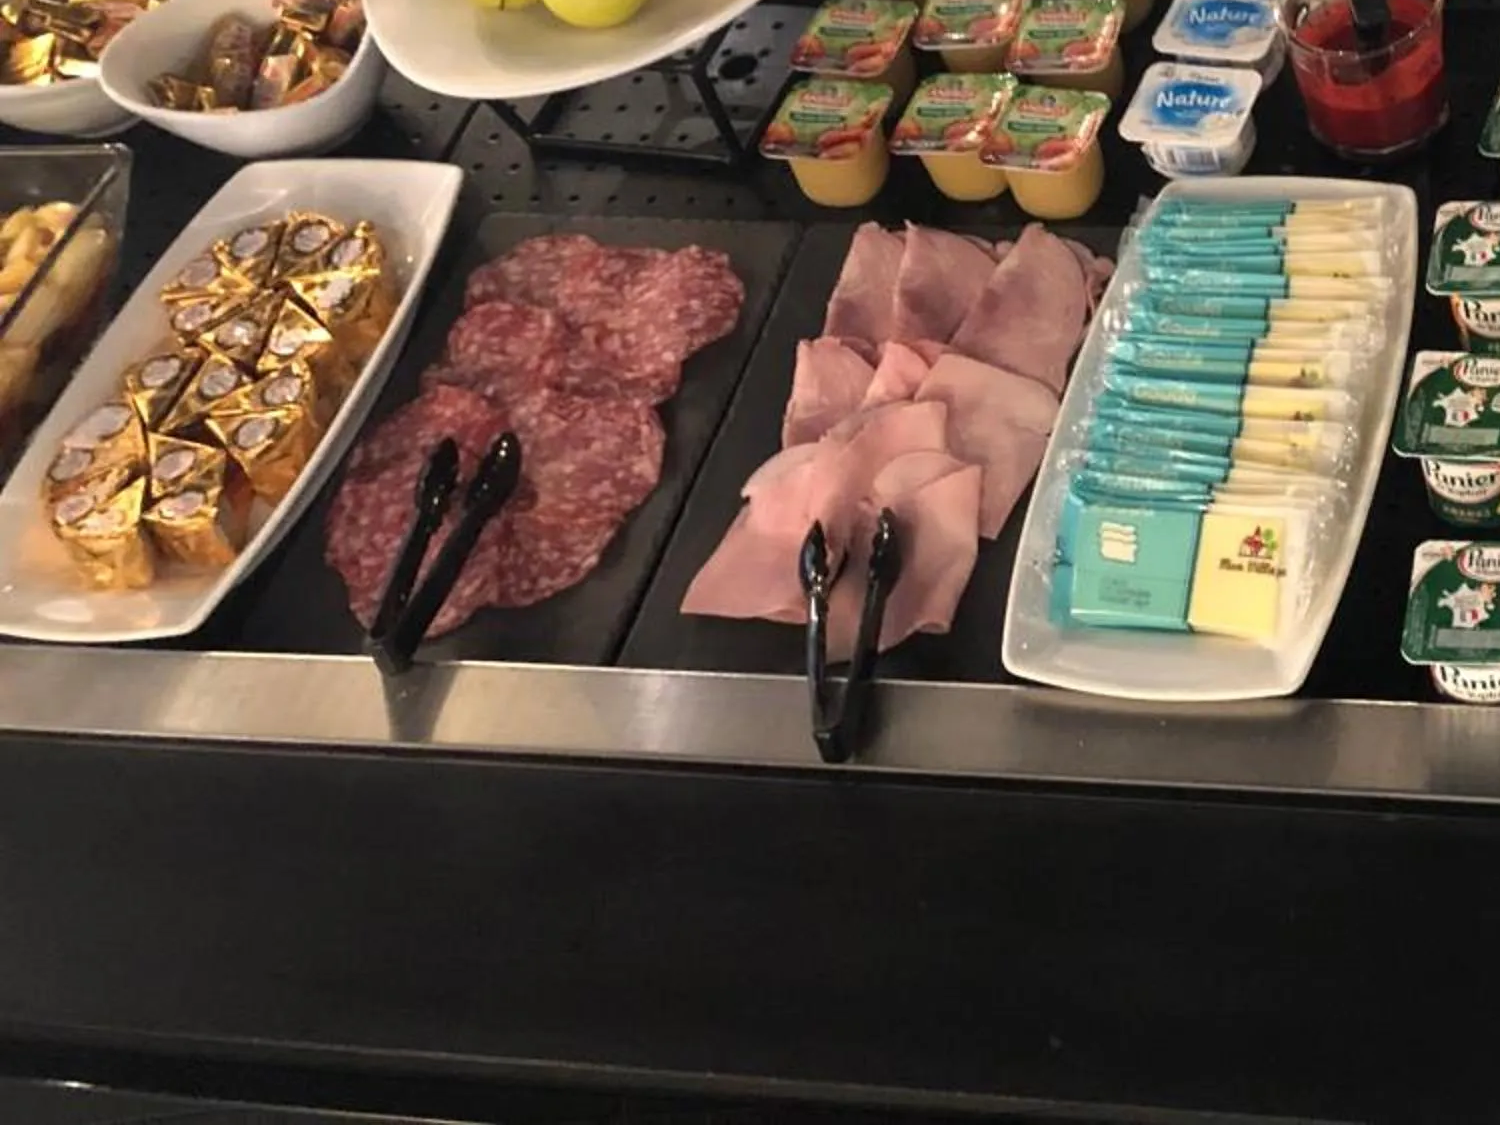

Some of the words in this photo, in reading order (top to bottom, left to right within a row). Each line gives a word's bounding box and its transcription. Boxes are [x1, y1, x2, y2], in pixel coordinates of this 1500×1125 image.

[1188, 5, 1262, 25] Nature
[1156, 89, 1231, 109] Nature
[1425, 459, 1499, 488] Panier
